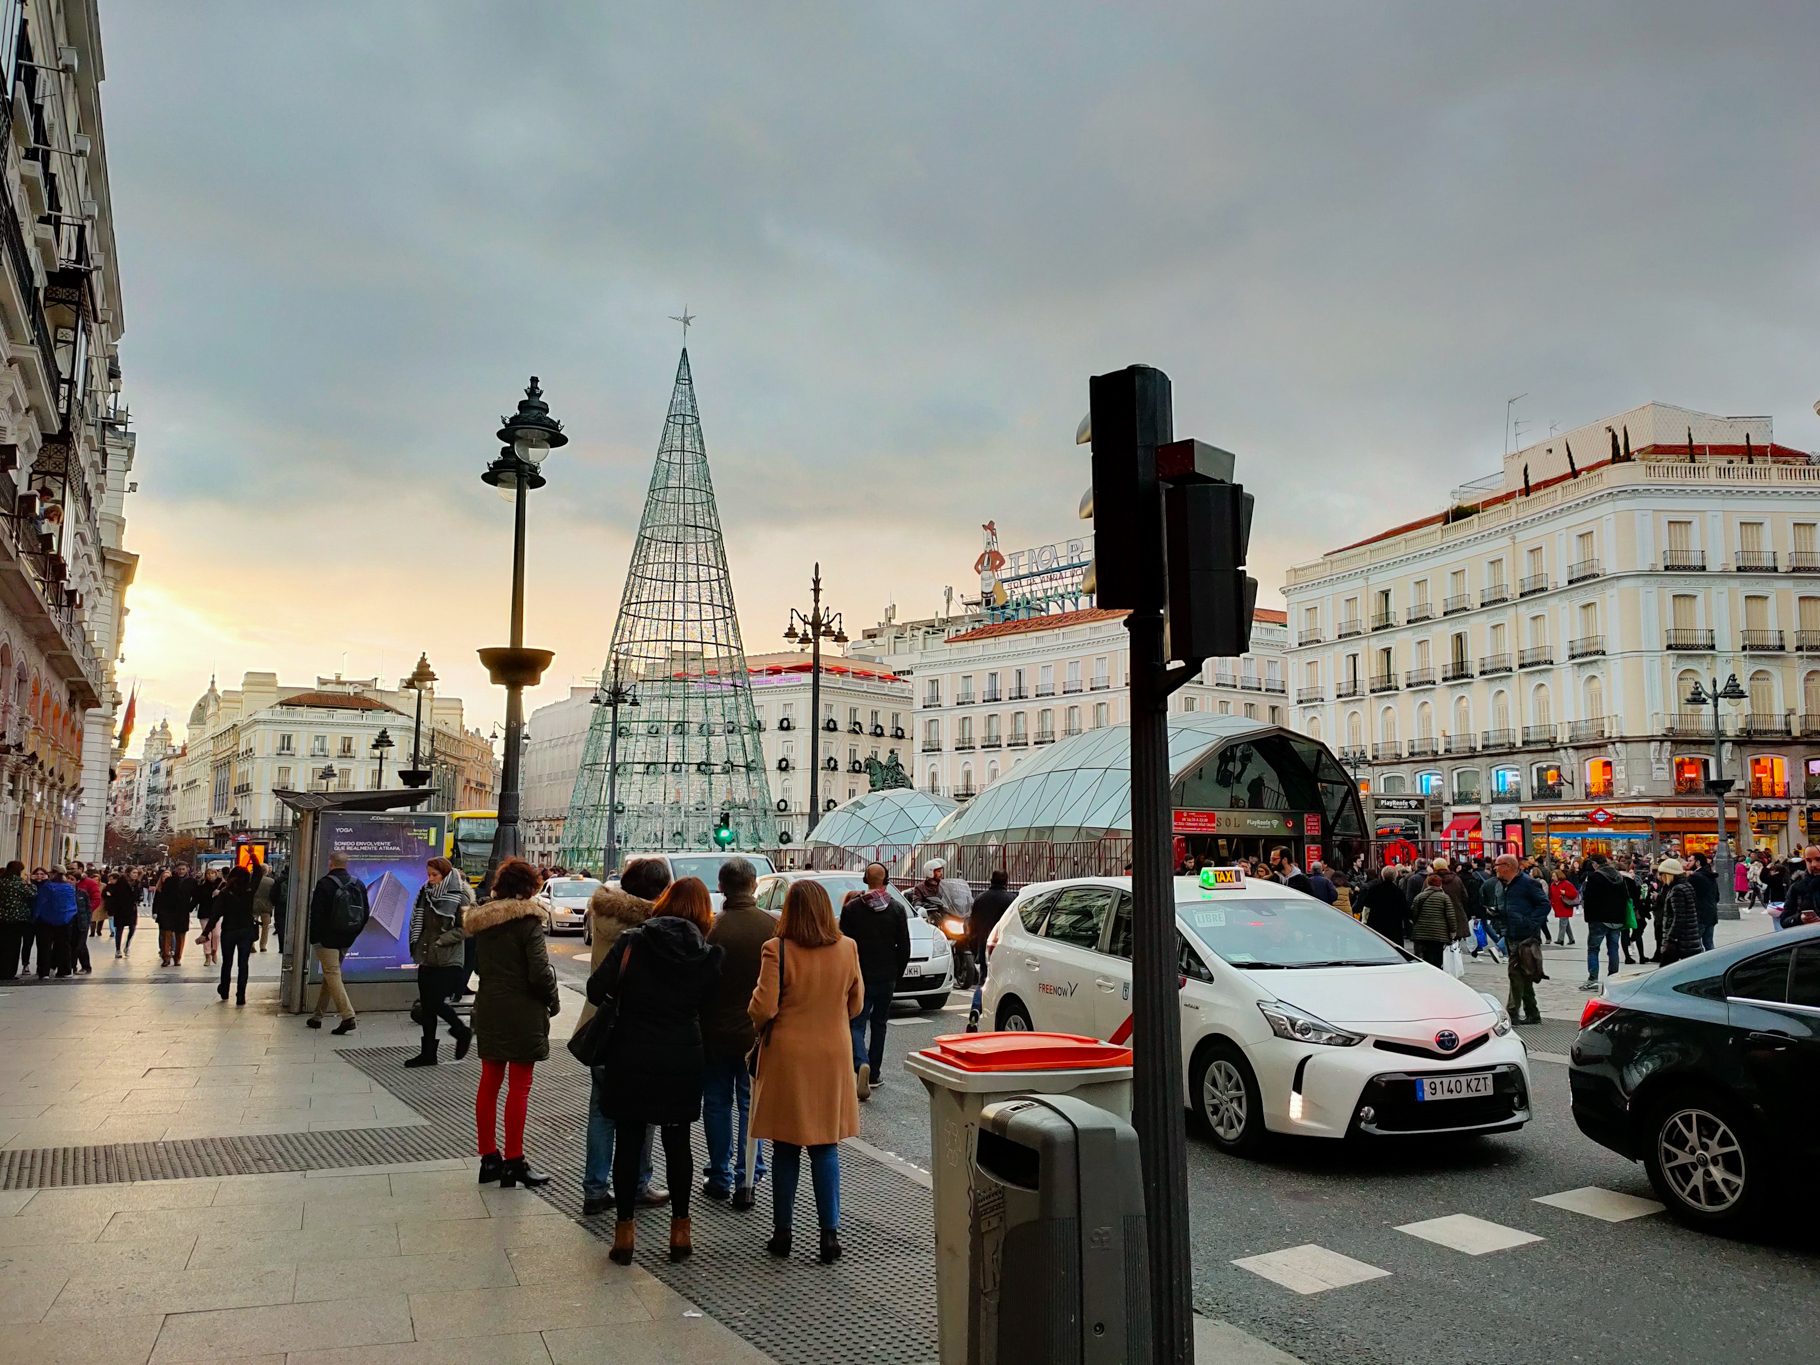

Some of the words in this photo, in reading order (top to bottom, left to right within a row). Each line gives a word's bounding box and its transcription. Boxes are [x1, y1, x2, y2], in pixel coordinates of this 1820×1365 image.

[1040, 568, 1084, 582] ANDALUCI
[1009, 582, 1082, 609] GONZALE
[1381, 799, 1409, 807] PlayRenfe
[1675, 807, 1716, 818] DIEGO
[1216, 817, 1241, 828] SOL
[1215, 870, 1234, 883] TAXI
[1429, 1080, 1462, 1096] 9140
[1466, 1077, 1488, 1093] KZT
